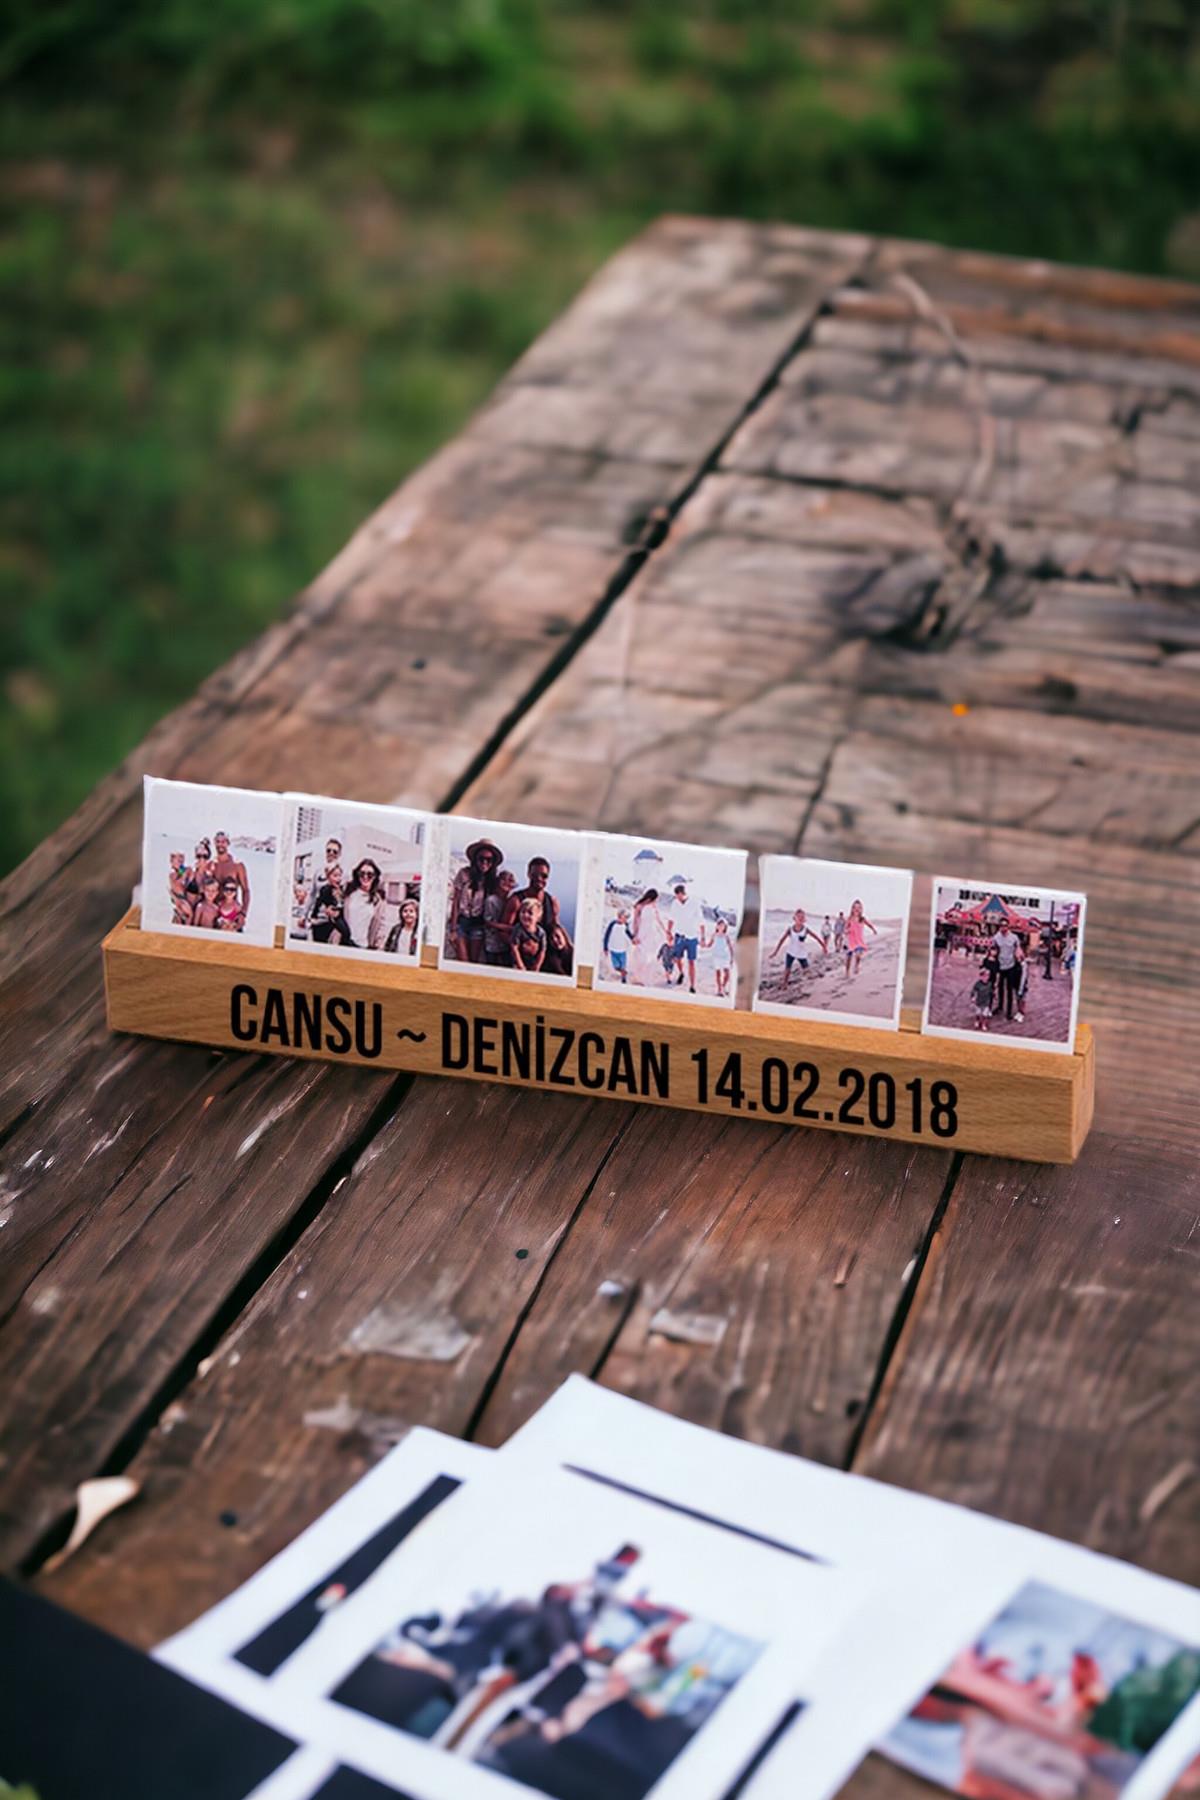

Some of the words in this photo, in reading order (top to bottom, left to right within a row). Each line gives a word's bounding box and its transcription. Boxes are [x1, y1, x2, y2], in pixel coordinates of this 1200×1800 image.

[230, 983, 383, 1060] CANSU
[441, 1011, 671, 1100] DENİZCAN
[690, 1047, 959, 1139] 14.02.2018
